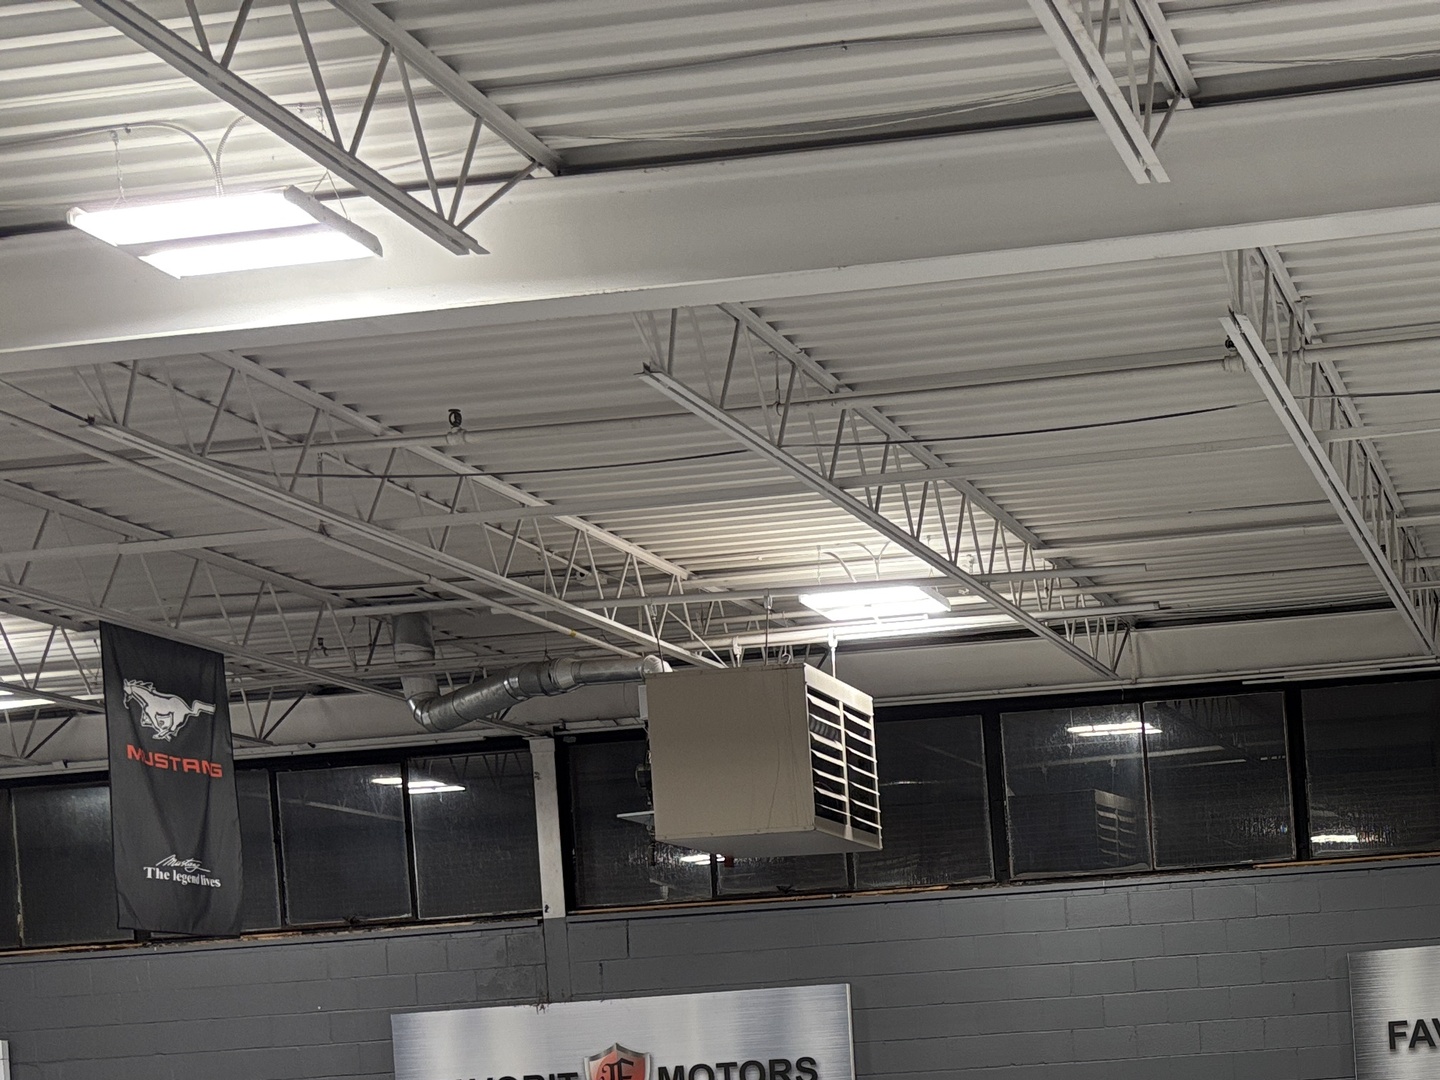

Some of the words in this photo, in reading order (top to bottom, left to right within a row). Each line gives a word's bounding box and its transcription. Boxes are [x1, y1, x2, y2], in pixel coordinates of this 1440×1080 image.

[126, 744, 223, 778] MUSTANG
[143, 866, 170, 880] The
[173, 869, 200, 886] legend
[200, 874, 221, 888] lives
